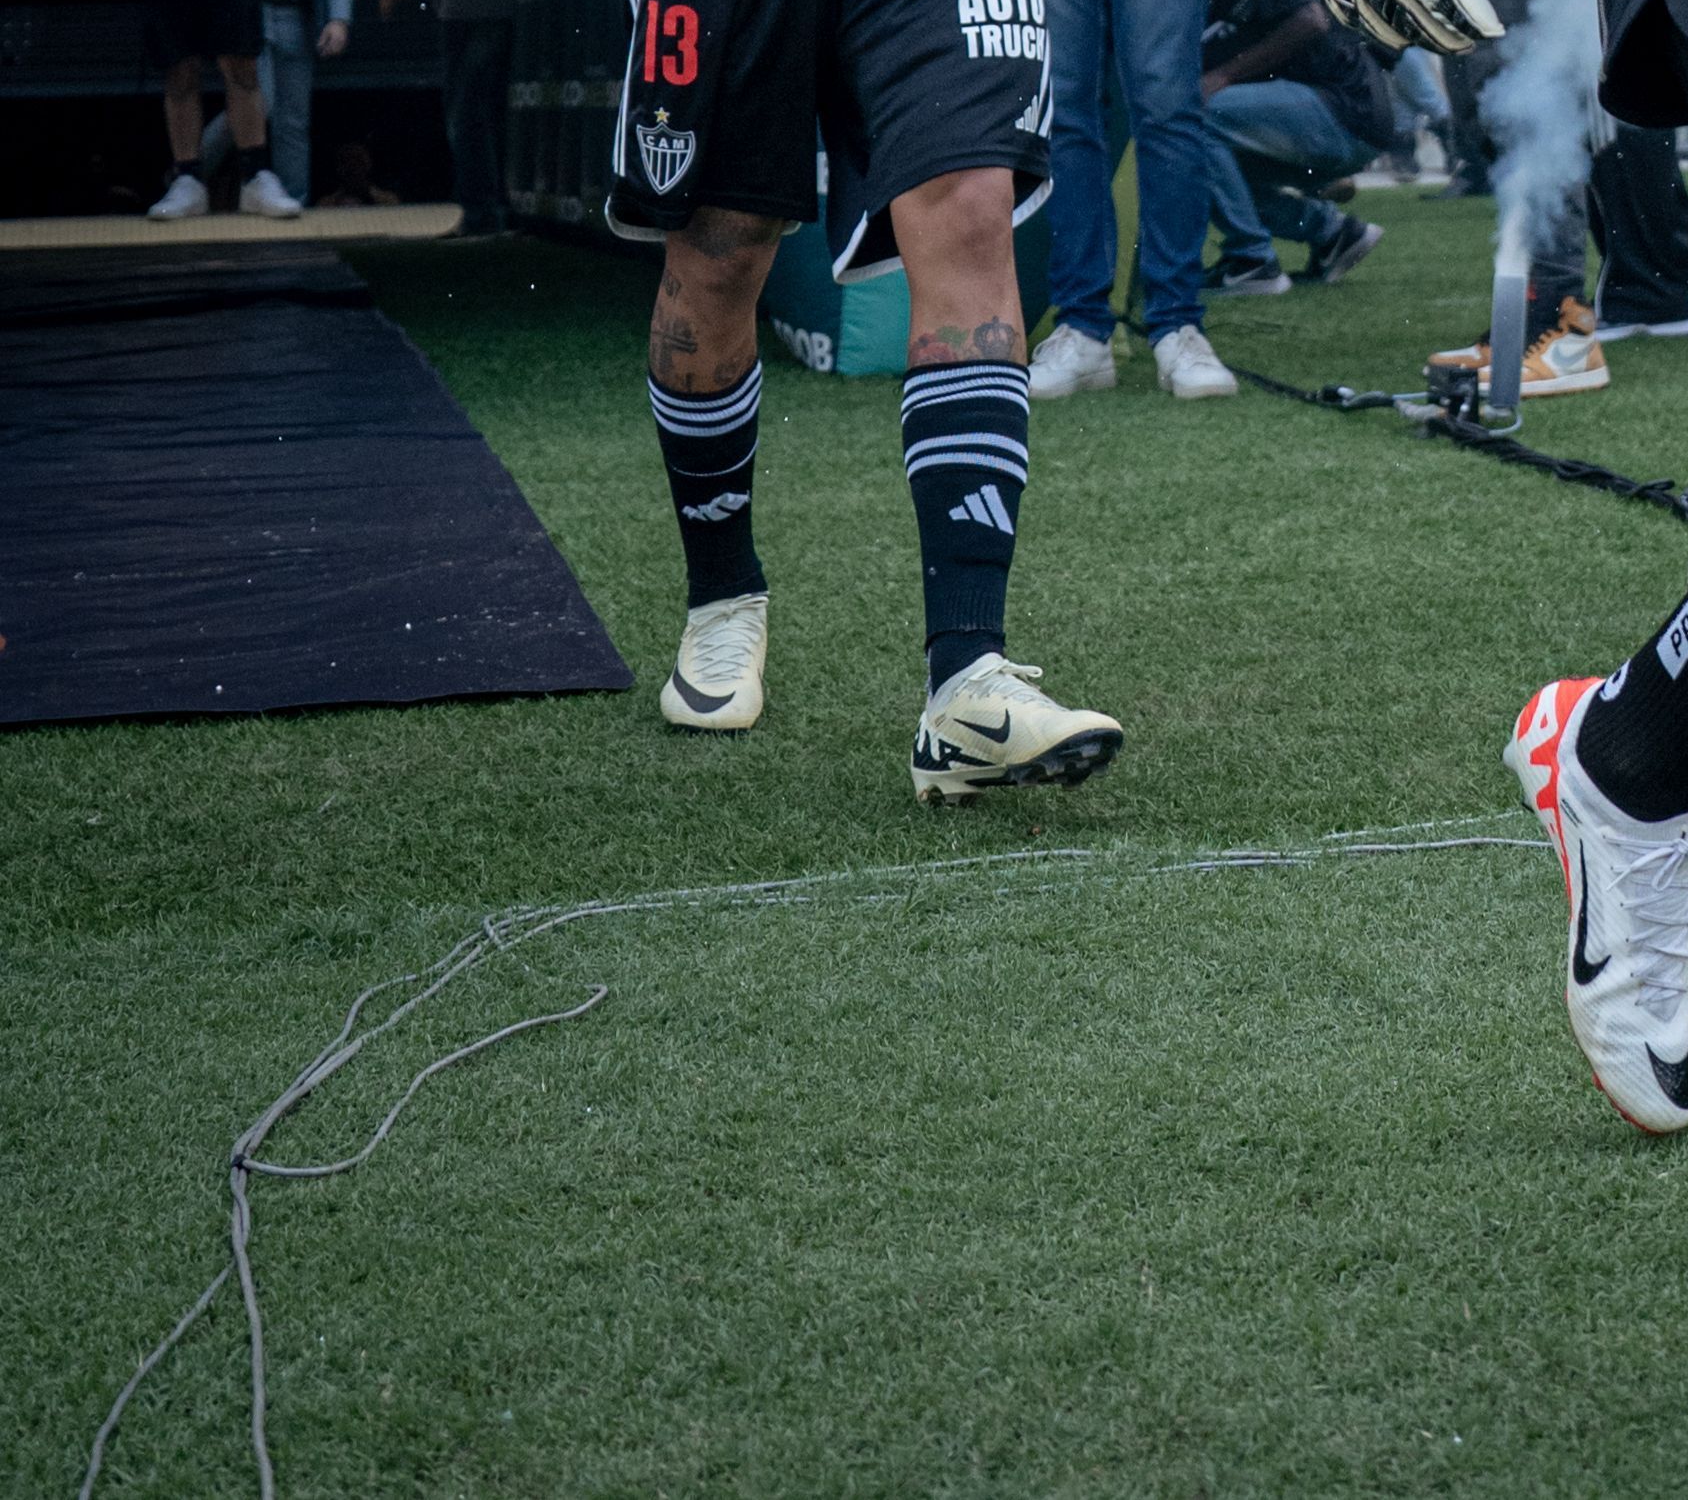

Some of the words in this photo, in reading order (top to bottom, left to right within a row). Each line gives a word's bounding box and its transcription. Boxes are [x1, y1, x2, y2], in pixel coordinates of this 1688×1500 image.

[643, 0, 699, 86] 13
[961, 24, 1045, 60] TRUCK
[646, 134, 686, 150] CAM
